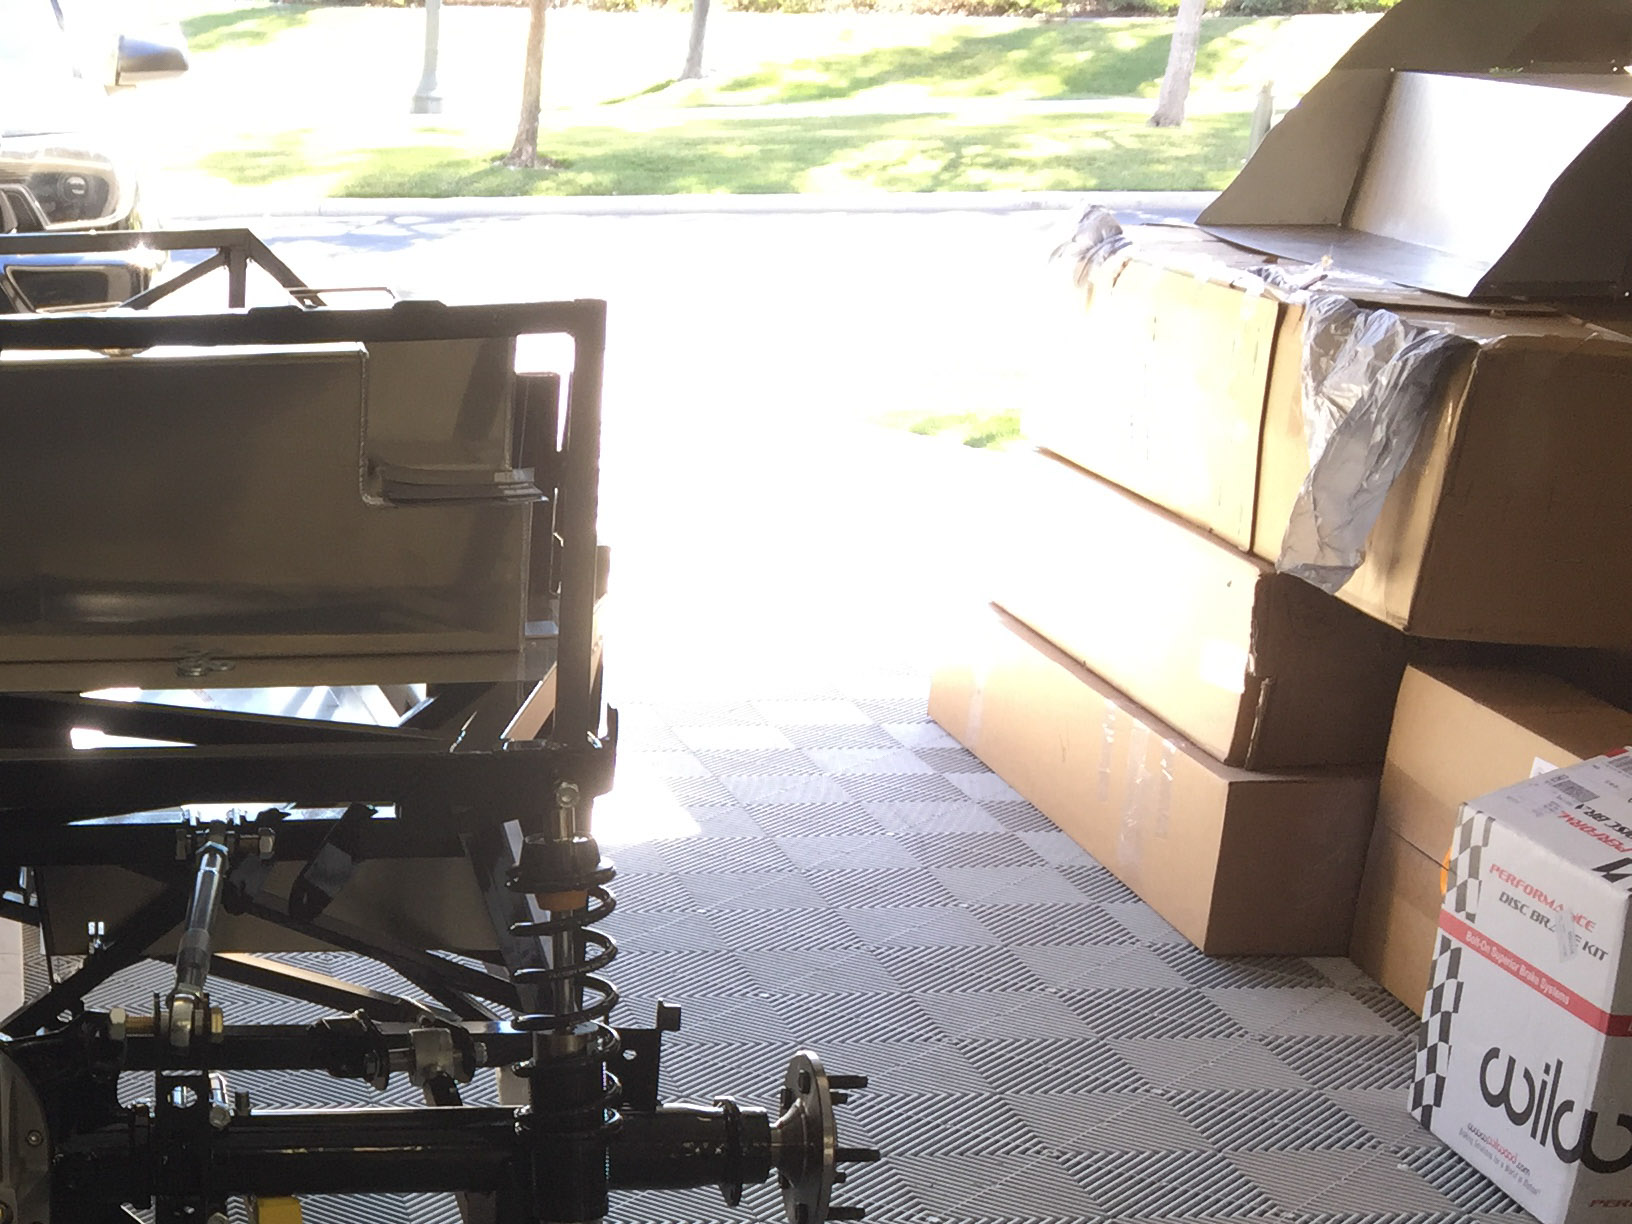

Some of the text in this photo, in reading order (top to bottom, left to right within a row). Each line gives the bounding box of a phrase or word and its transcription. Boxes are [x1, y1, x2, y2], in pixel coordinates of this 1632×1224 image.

[1499, 891, 1608, 961] DISC BRE KIT
[1490, 947, 1519, 972] Superior
[1519, 964, 1539, 986] Brake
[1540, 978, 1570, 1005] Systems
